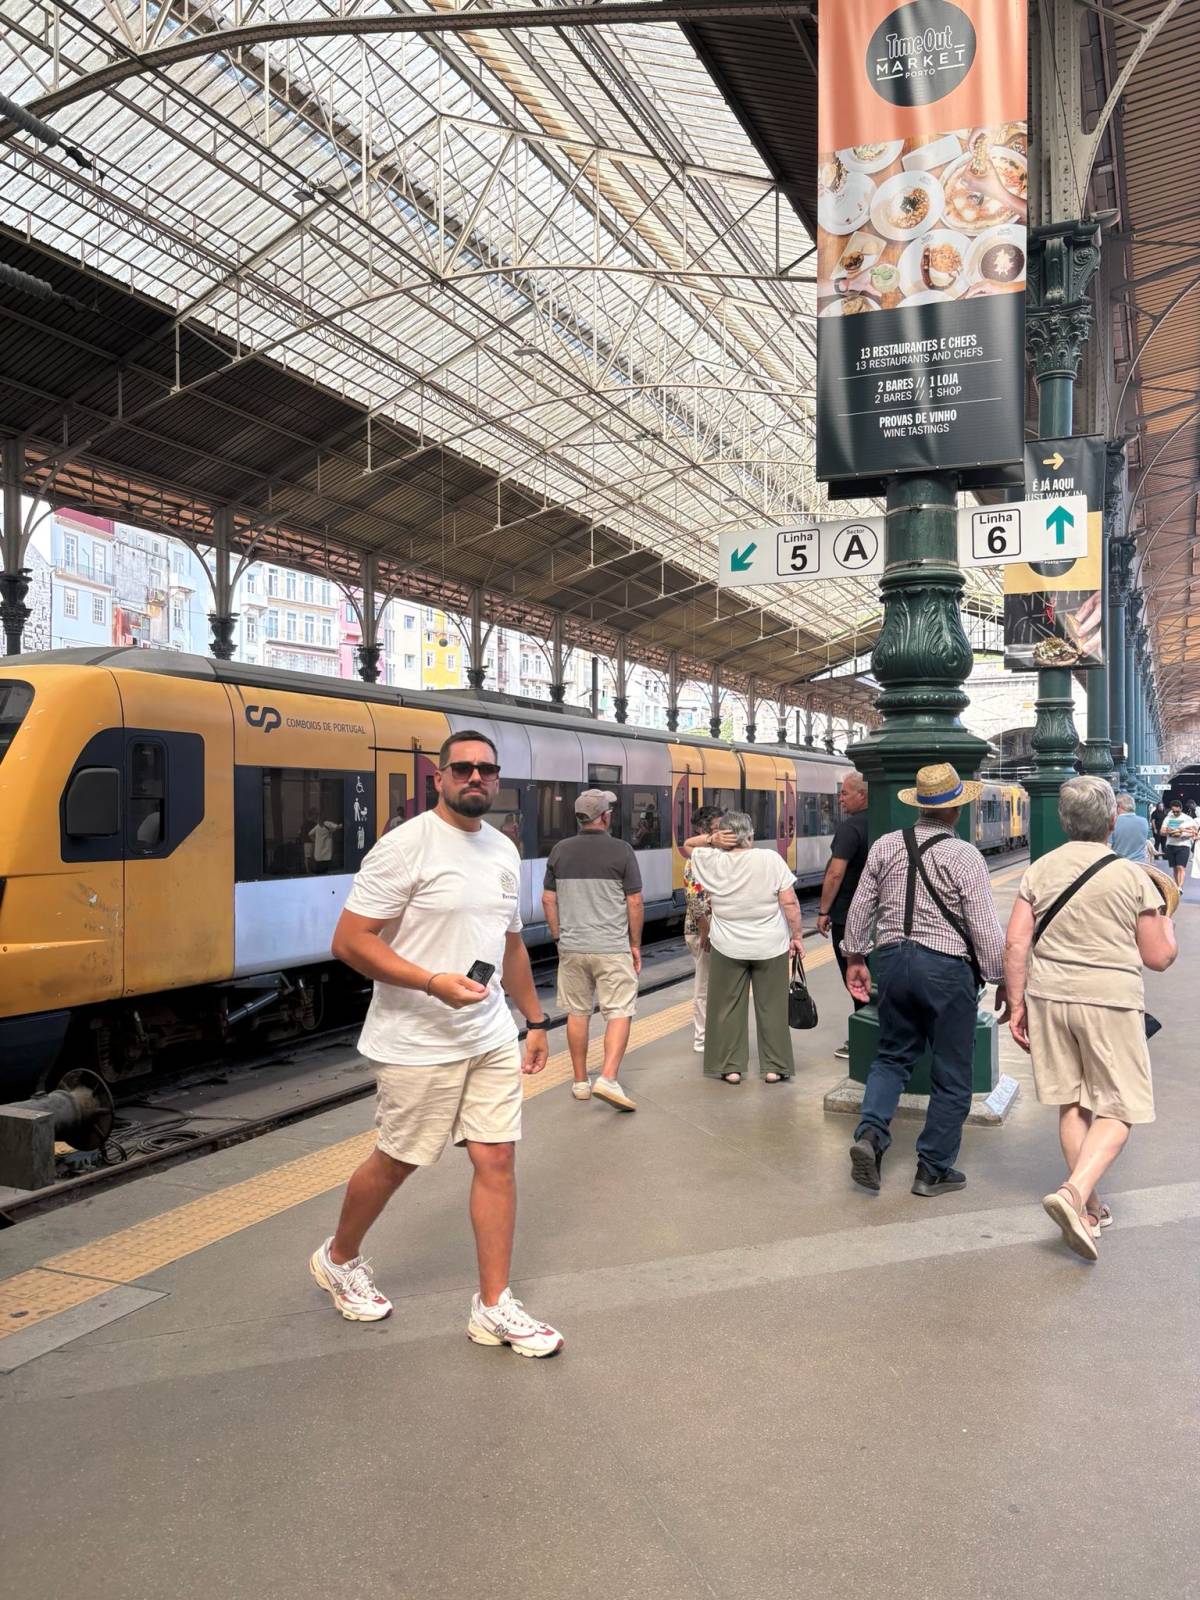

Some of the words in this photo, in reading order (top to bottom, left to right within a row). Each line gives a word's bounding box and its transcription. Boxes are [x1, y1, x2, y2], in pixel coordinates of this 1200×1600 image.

[876, 49, 965, 76] MARKET
[905, 68, 936, 78] PORTO
[860, 347, 870, 359] 13
[872, 339, 938, 358] RESTAURANTES
[940, 338, 946, 349] E
[948, 334, 977, 349] CHEFS
[855, 361, 867, 371] 13
[869, 353, 930, 369] RESTAURANTS
[932, 350, 951, 362] AND
[953, 346, 983, 359] CHEFS
[877, 381, 883, 392] 2
[885, 377, 914, 391] BARES
[930, 376, 935, 387] 1
[937, 373, 959, 386] LOJA
[874, 394, 880, 404] 2
[883, 391, 912, 403] BARES
[928, 389, 933, 398] 1
[936, 385, 962, 397] SHOP
[879, 413, 913, 428] PROVAS
[915, 412, 928, 424] DE
[929, 409, 957, 423] VINHO
[883, 427, 906, 438] WINE
[907, 423, 950, 436] TASTINGS
[1032, 478, 1038, 491] É
[1040, 477, 1050, 491] JÁ
[1052, 477, 1074, 490] AQUI
[979, 513, 1013, 524] Linha
[783, 532, 813, 543] Linha
[987, 526, 1007, 554] 6
[790, 544, 808, 571] 5
[842, 534, 868, 562] A
[286, 718, 321, 730] COMBOIOS
[323, 722, 331, 731] DE
[333, 723, 366, 734] PORTUGAL
